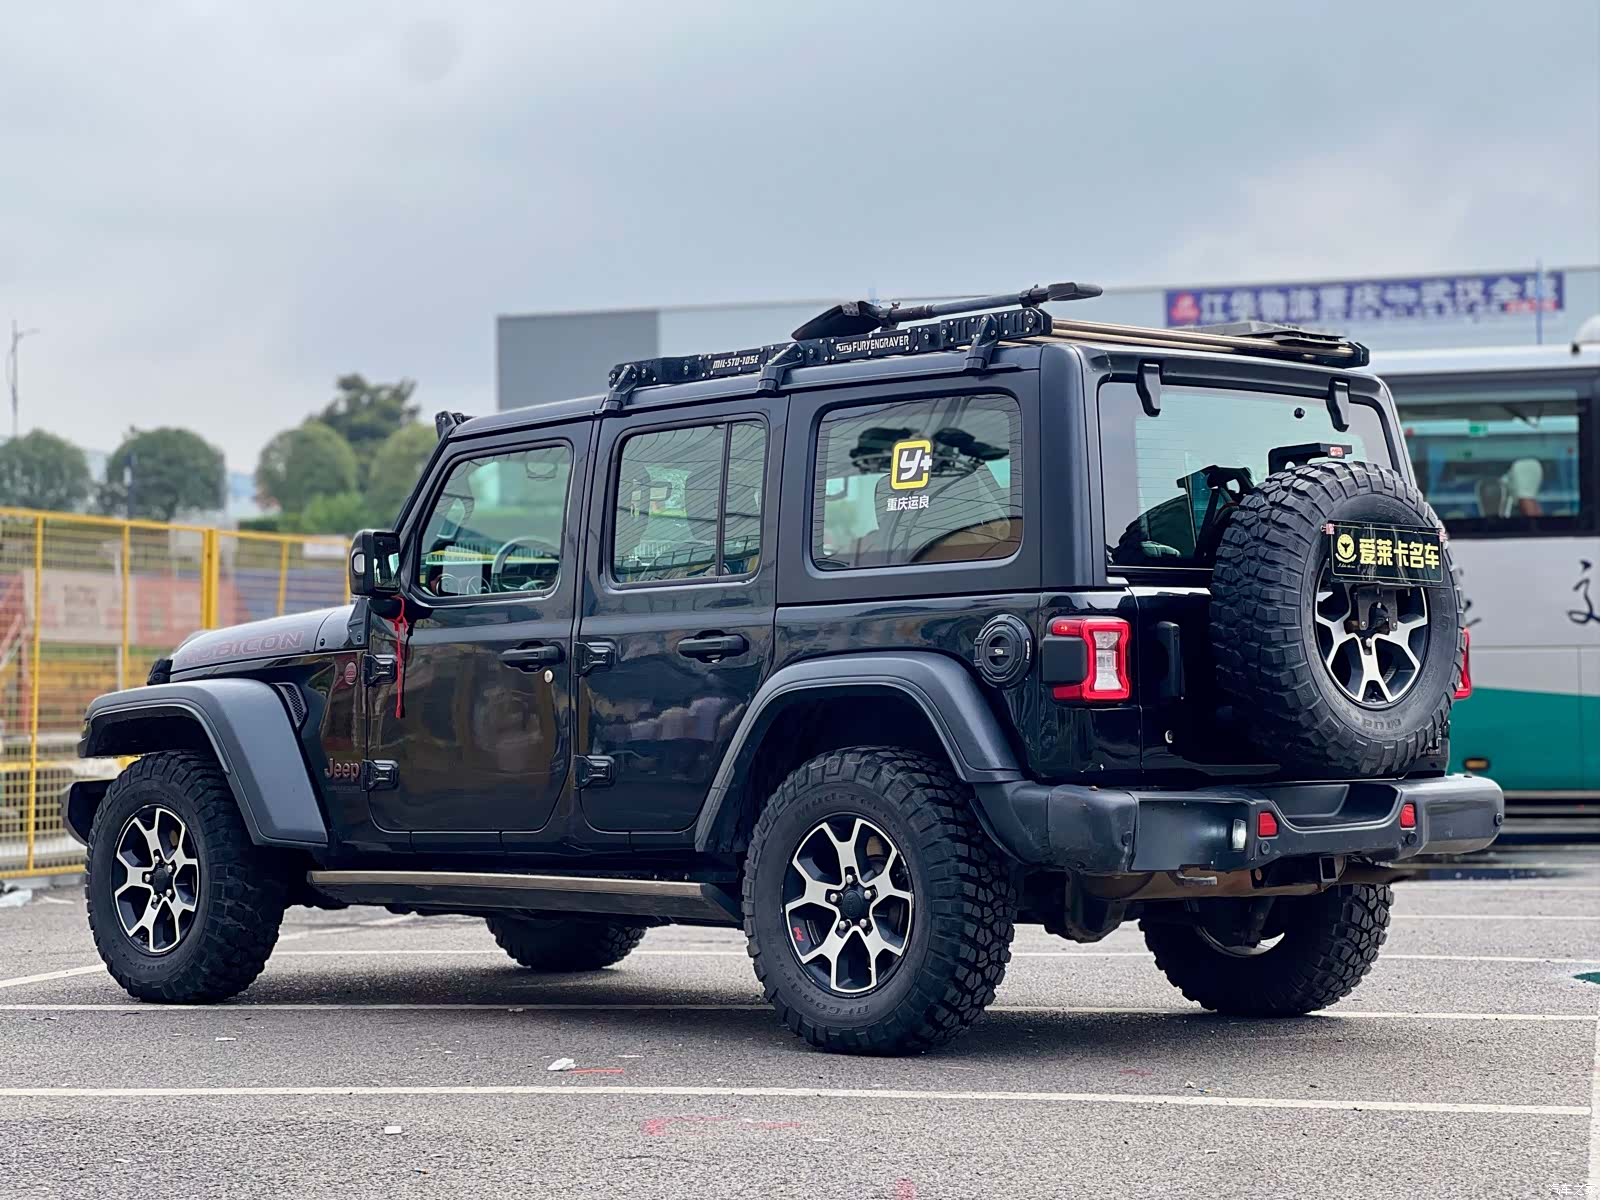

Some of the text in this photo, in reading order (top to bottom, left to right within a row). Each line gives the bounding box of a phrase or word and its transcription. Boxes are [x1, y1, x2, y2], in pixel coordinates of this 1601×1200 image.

[852, 335, 909, 352] FURYENGRAVER
[886, 495, 930, 512] 重庆运良
[1359, 538, 1440, 570] 爱莱卡名车
[323, 757, 360, 783] Jeep
